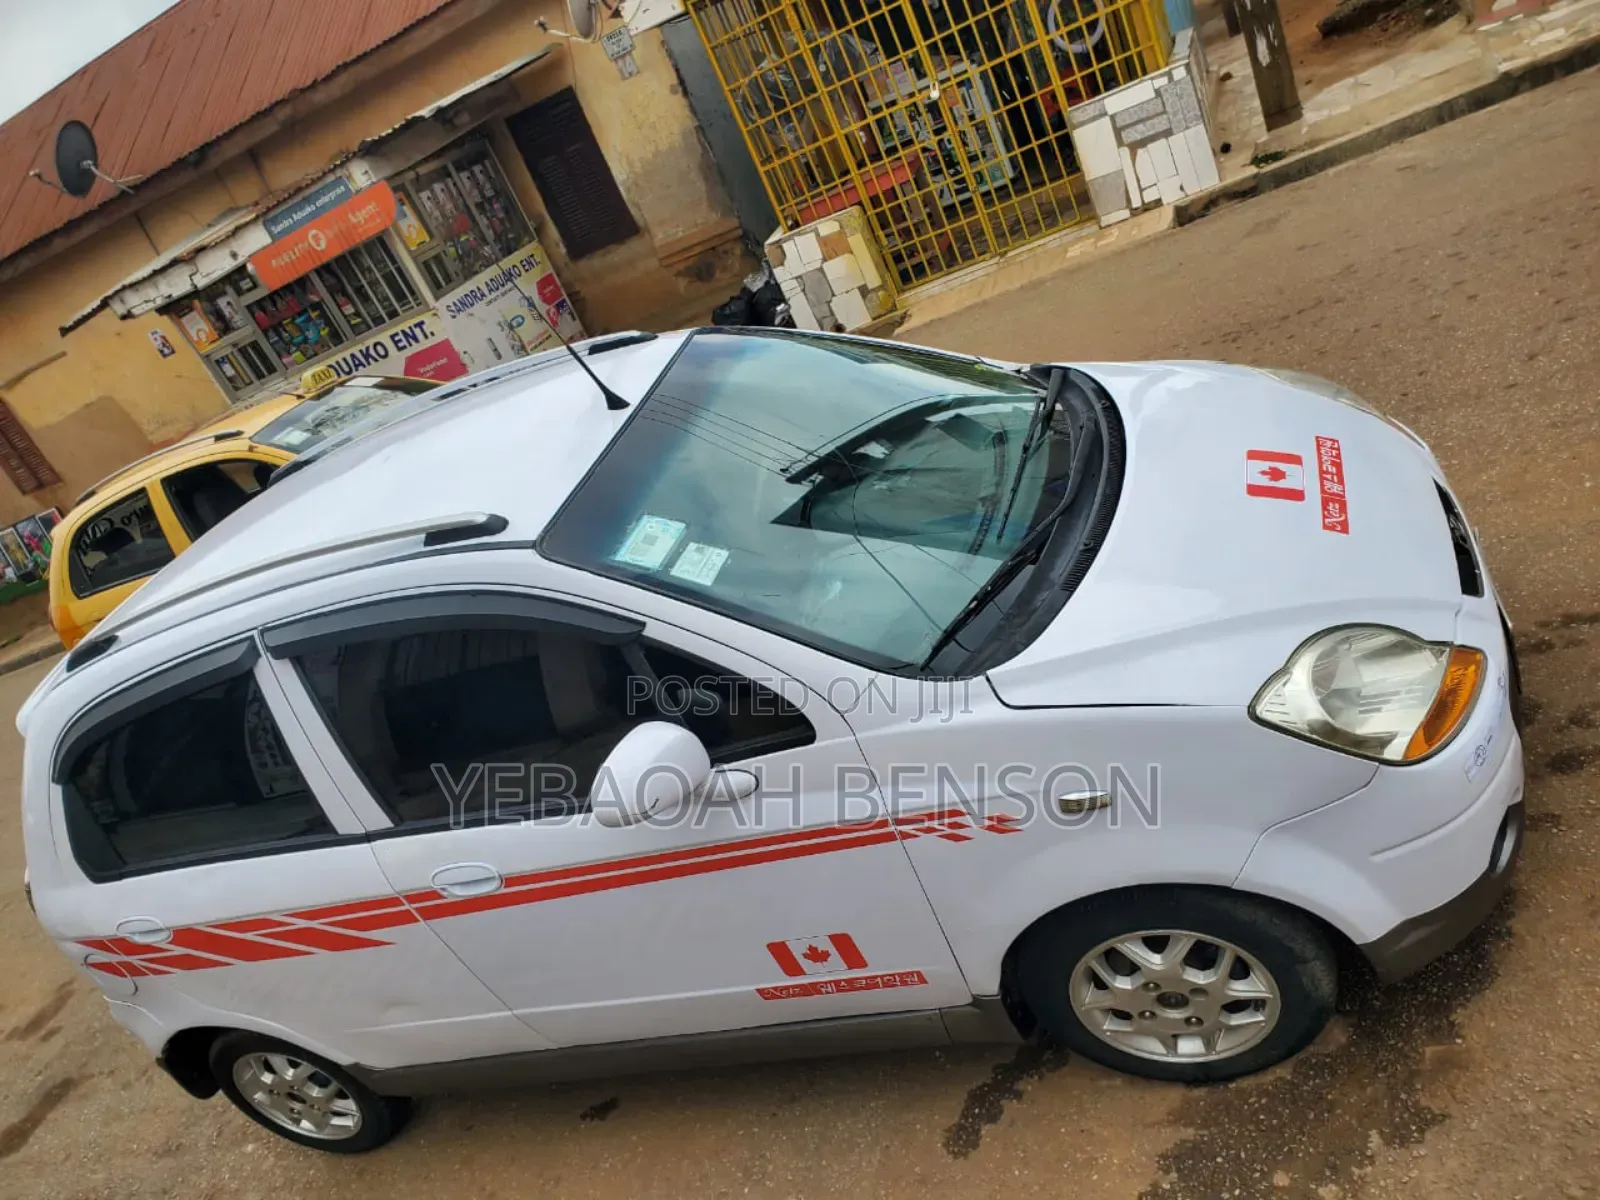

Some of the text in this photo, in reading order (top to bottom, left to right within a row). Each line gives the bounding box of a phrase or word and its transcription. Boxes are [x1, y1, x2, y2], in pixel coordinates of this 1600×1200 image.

[445, 253, 541, 319] SANDRA ADUAKO ENT.
[389, 320, 435, 352] ENT.
[310, 367, 331, 385] TAXI
